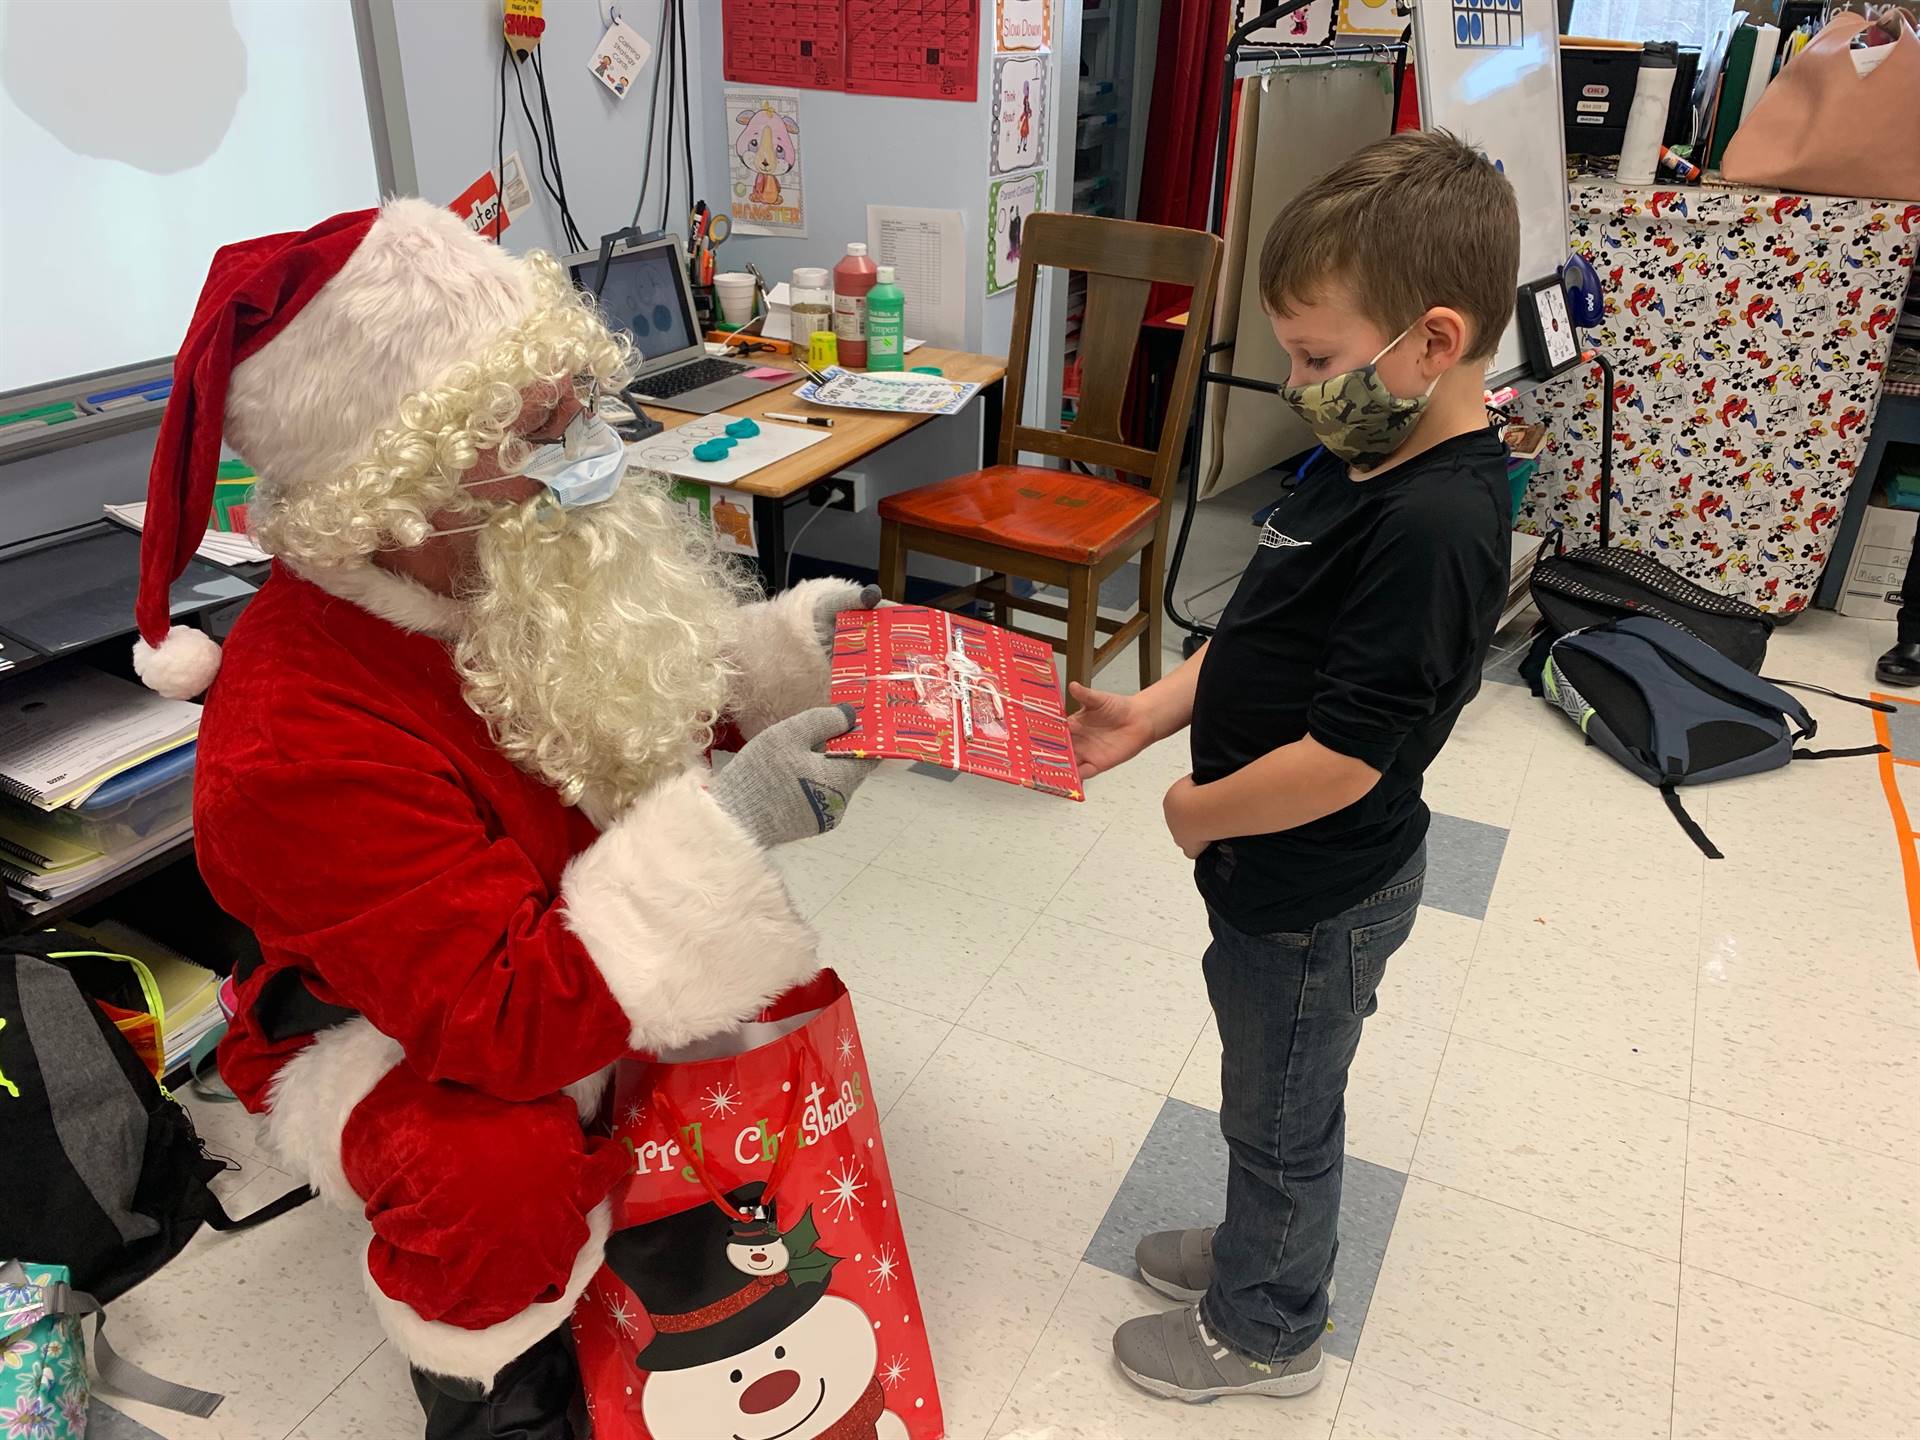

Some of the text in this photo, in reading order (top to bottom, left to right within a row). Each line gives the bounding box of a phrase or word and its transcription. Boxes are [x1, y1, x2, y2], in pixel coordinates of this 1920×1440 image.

[1003, 17, 1041, 37] Slow Down
[1004, 90, 1016, 102] Think
[732, 202, 800, 224] HAMSTER
[621, 1071, 866, 1184] rry Chstmas
